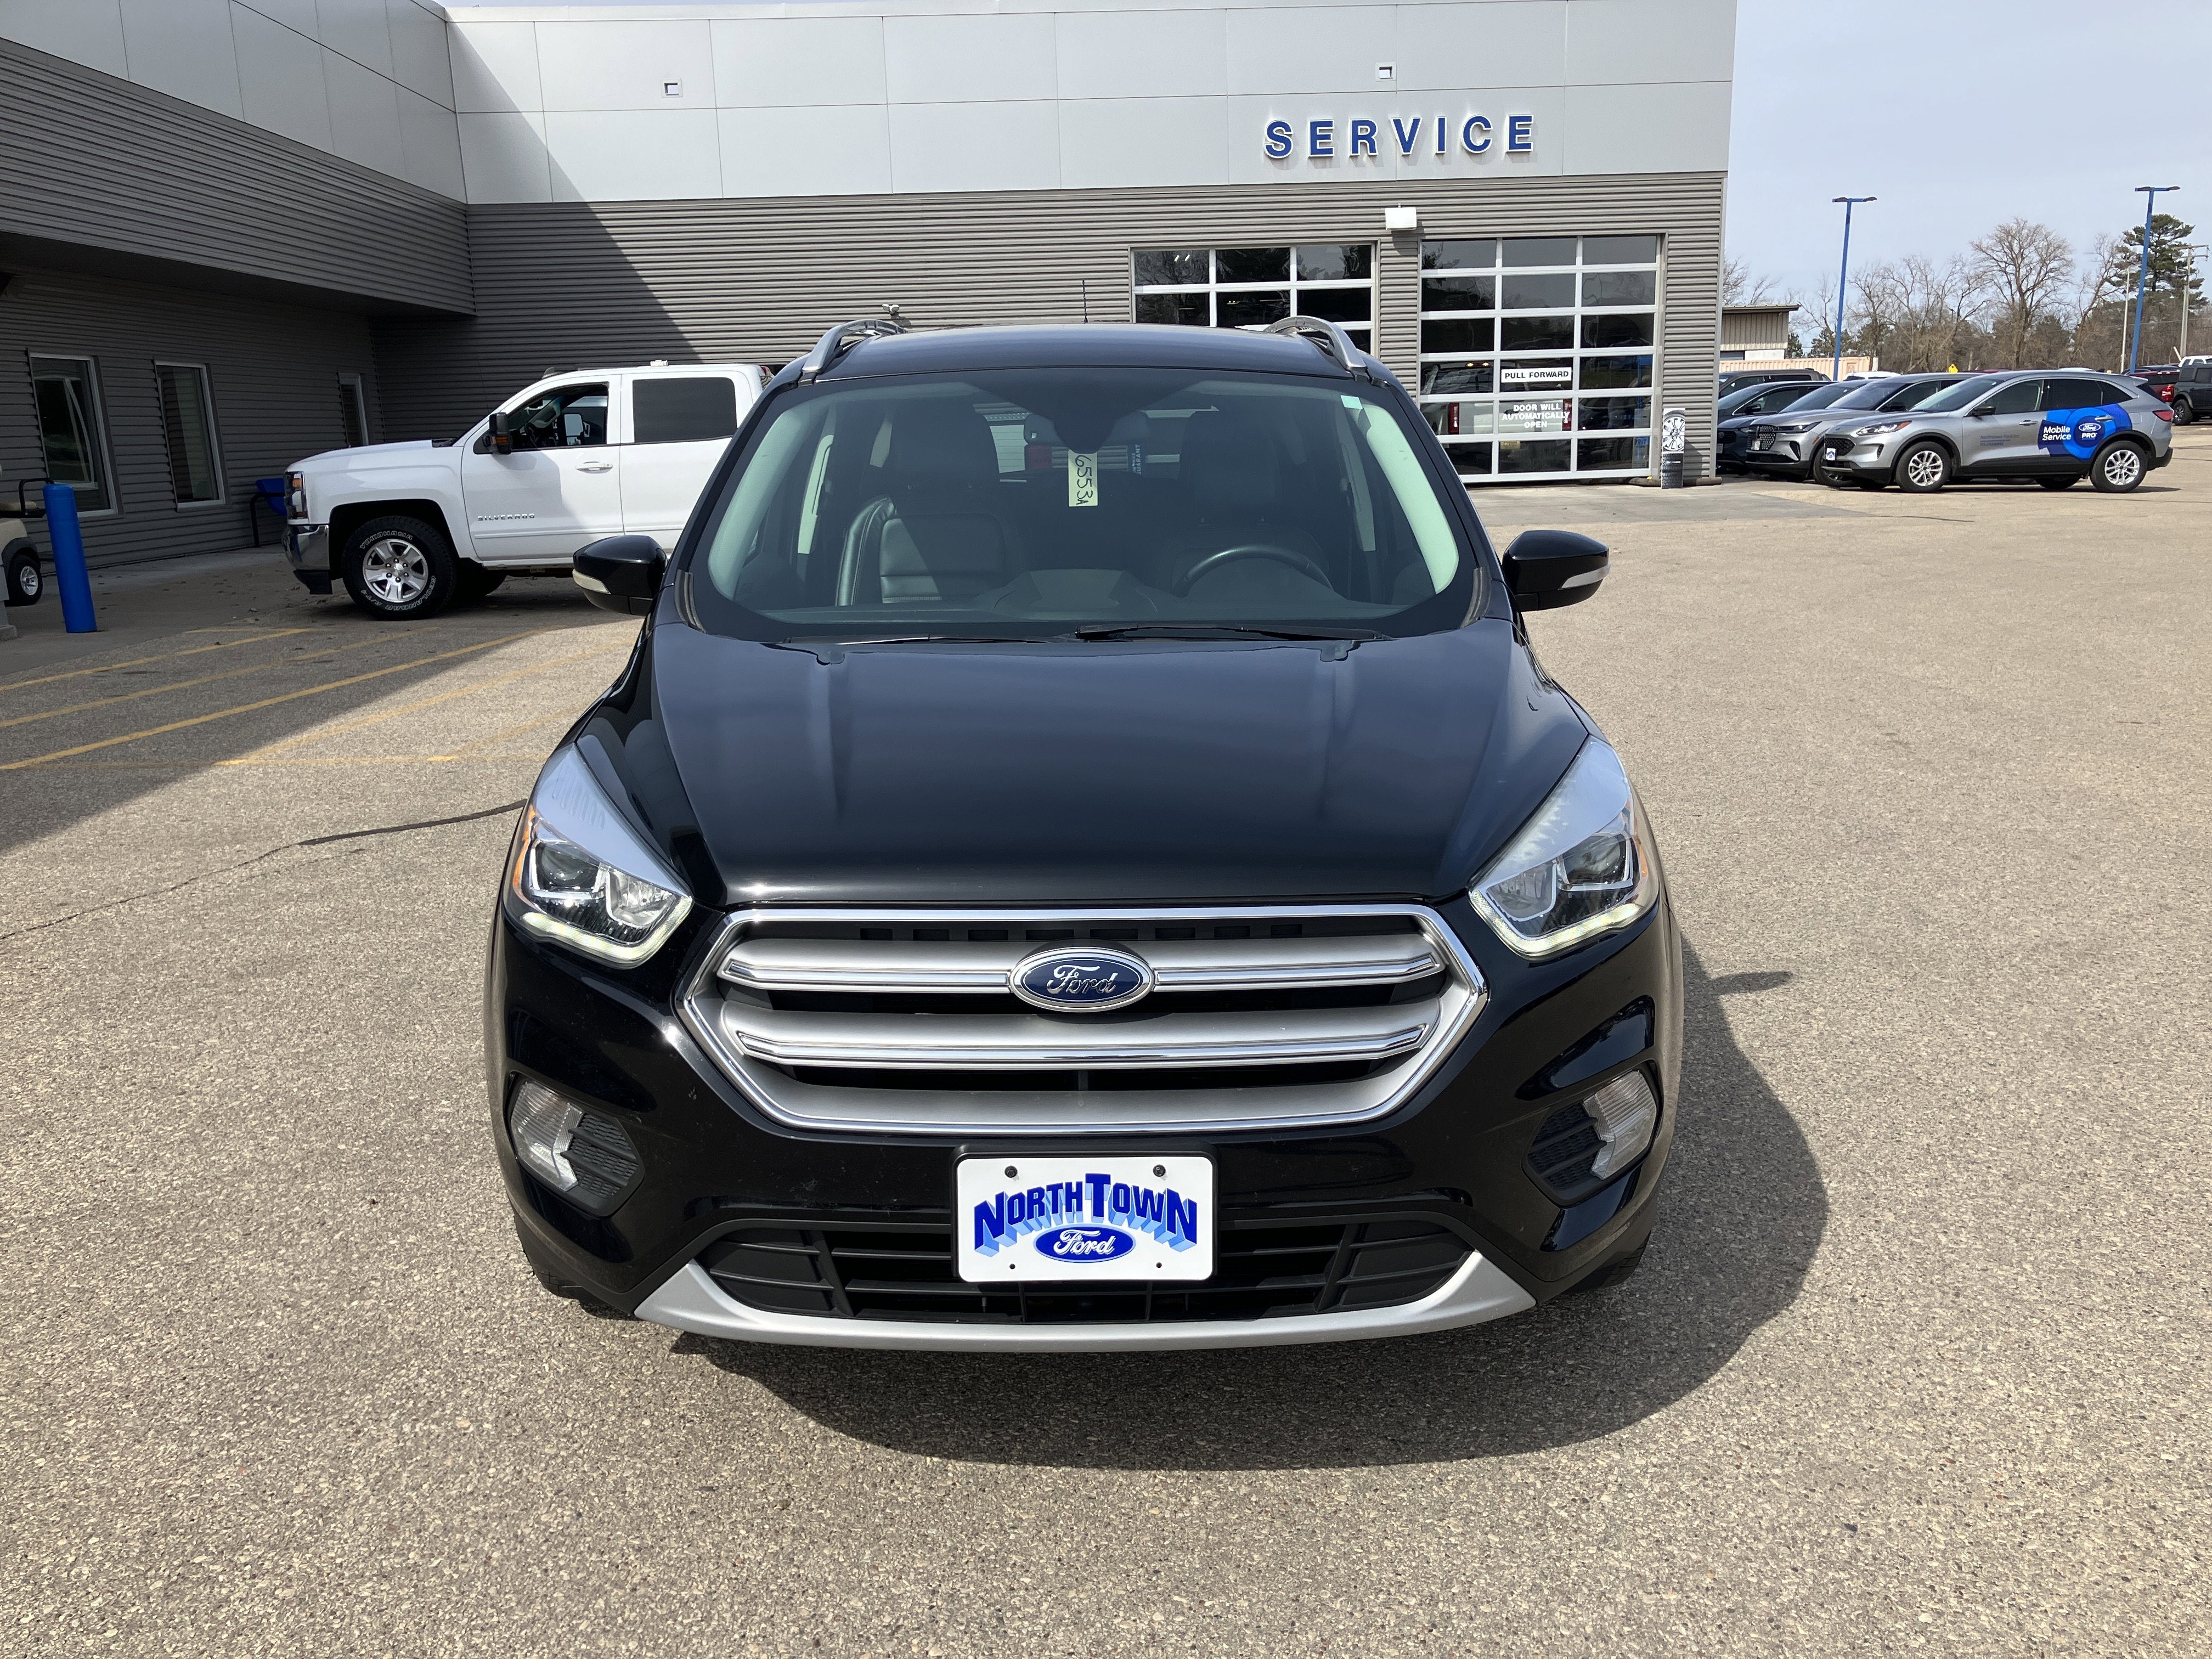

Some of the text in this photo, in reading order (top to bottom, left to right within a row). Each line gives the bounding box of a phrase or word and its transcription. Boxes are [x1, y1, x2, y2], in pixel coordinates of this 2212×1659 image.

[1264, 114, 1534, 159] SERVICE
[1502, 411, 1570, 420] AUTOMATICALLY
[1075, 455, 1093, 505] 6553A
[478, 513, 535, 521] SILVERADO
[360, 531, 413, 549] YOKOHAMA
[1047, 964, 1118, 994] Ford
[1053, 1229, 1115, 1255] Ford
